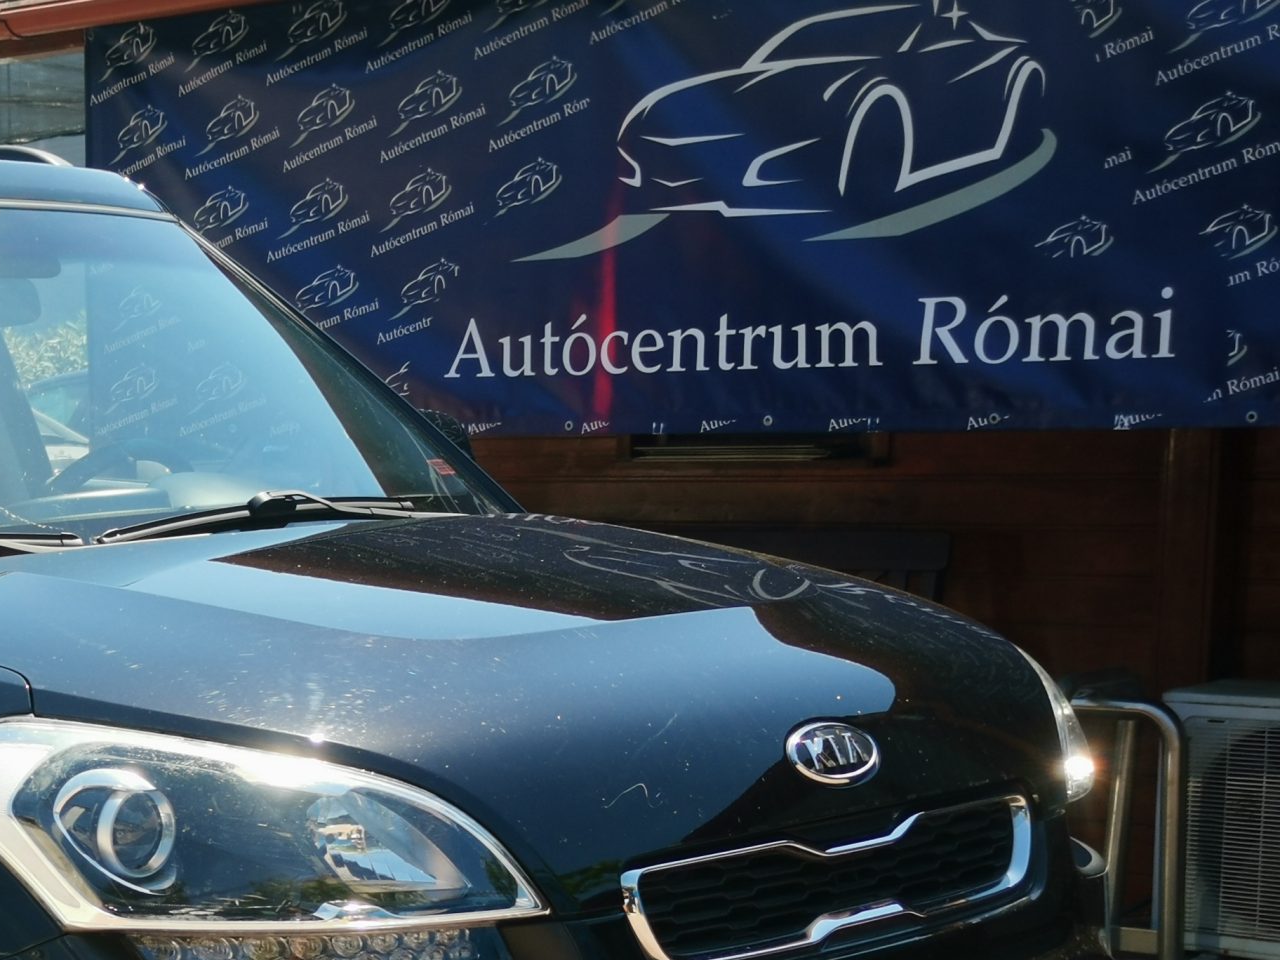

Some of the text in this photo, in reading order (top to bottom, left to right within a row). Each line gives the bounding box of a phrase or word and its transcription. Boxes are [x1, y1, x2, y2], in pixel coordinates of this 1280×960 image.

[364, 10, 473, 74] Autócentrum Római
[474, 15, 550, 61] Autócentrum
[589, 1, 669, 46] Autócentrum
[1104, 26, 1155, 59] Római
[89, 51, 176, 107] Autócentrum Római
[178, 40, 268, 98] Autócentrum Római
[265, 26, 368, 87] Autócentrum Római
[1155, 34, 1263, 87] Autócentrum
[155, 135, 187, 159] Római
[184, 126, 281, 180] Autócentrum Római
[282, 115, 378, 173] Autócentrum Római
[379, 102, 487, 163] Autócentrum Római
[488, 111, 561, 152] Autócentrum
[1132, 142, 1280, 205] Autócentrum Róm
[235, 217, 269, 241] Római
[266, 229, 336, 264] Autócentrum
[337, 210, 371, 234] Római
[369, 201, 476, 257] Autócentrum Római
[343, 298, 380, 321] Római
[443, 286, 1175, 378] Autócentrum Római
[1226, 366, 1280, 395] Római
[800, 732, 871, 770] KIA
